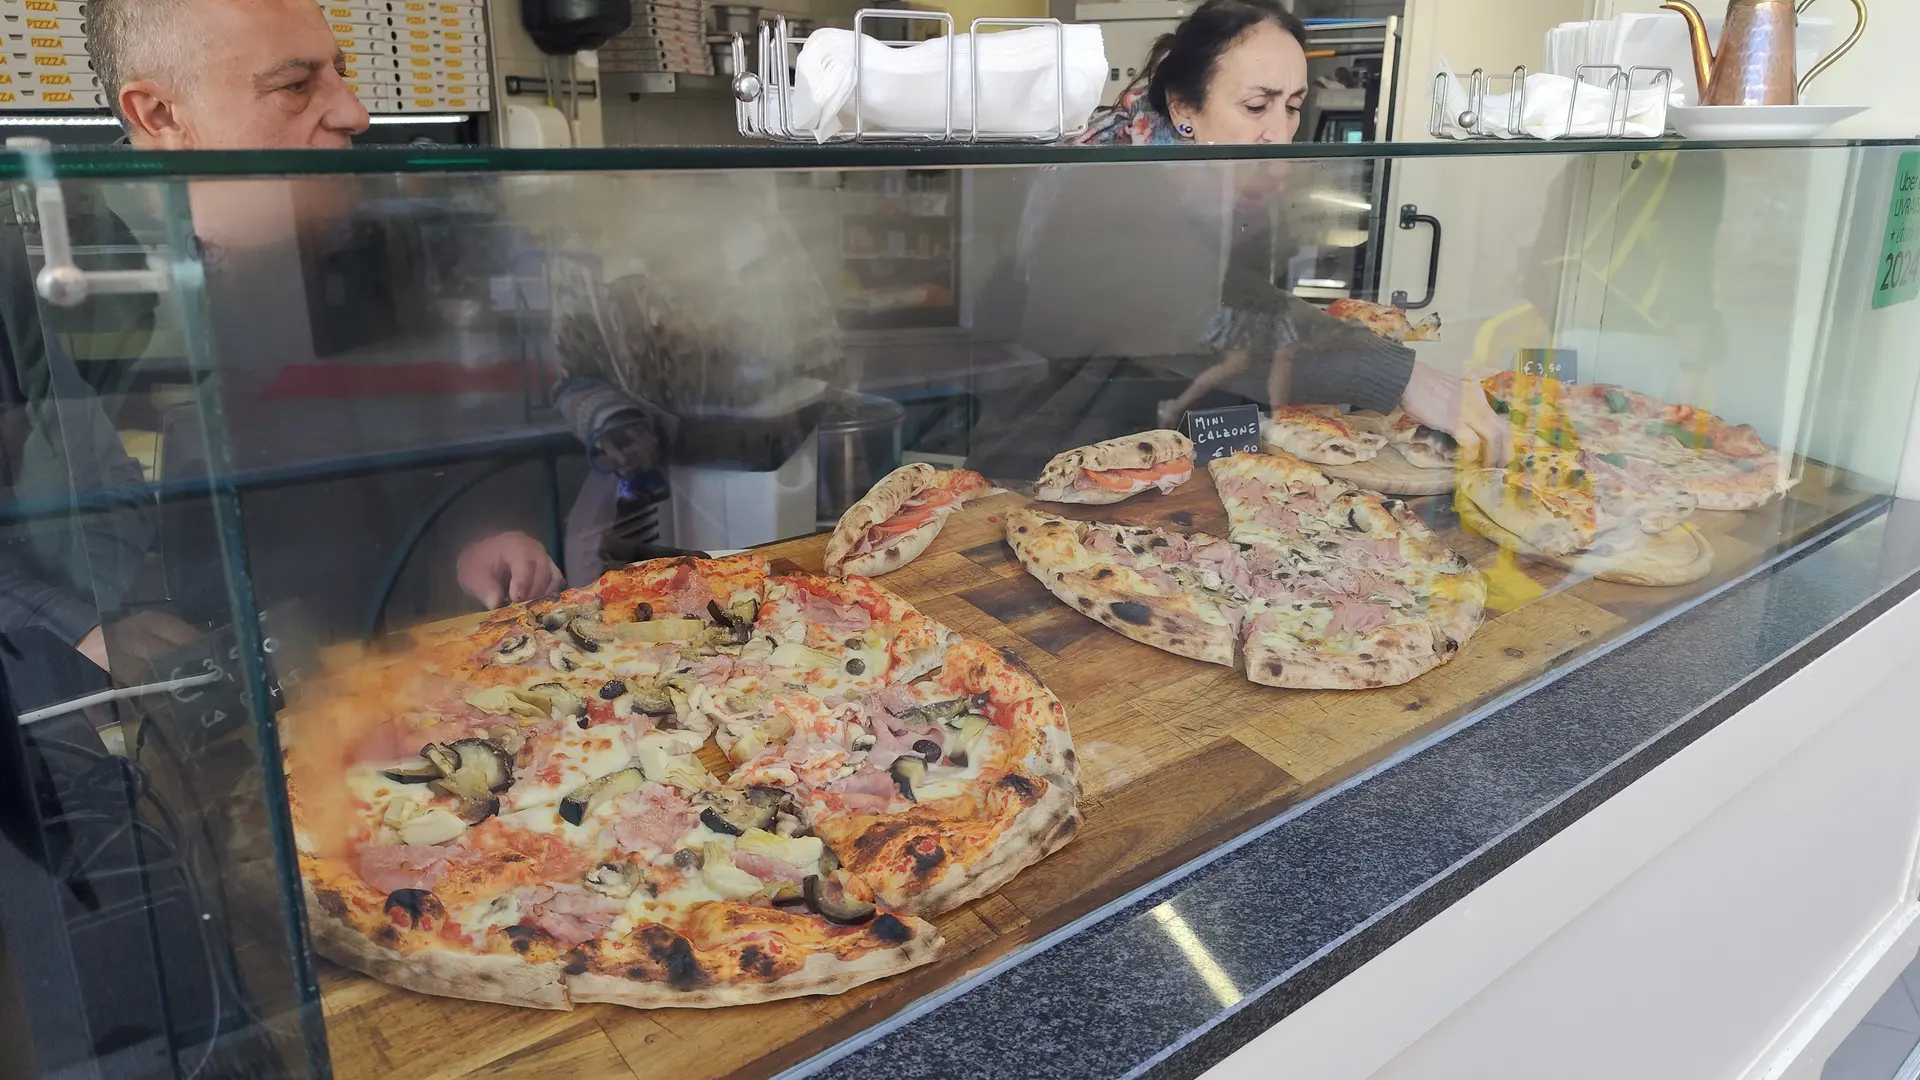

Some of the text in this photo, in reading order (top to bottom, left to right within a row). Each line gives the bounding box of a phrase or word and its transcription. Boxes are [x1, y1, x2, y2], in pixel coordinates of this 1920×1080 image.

[25, 1, 58, 11] PIZZA
[27, 19, 59, 29] PIZZA
[31, 37, 62, 48] PIZZA
[34, 56, 67, 66] PIZZA
[40, 74, 71, 85] PIZZA
[42, 92, 74, 102] PIZZA
[1900, 171, 1918, 191] Uber
[1195, 416, 1224, 430] MINI
[1198, 422, 1257, 444] CALZONE
